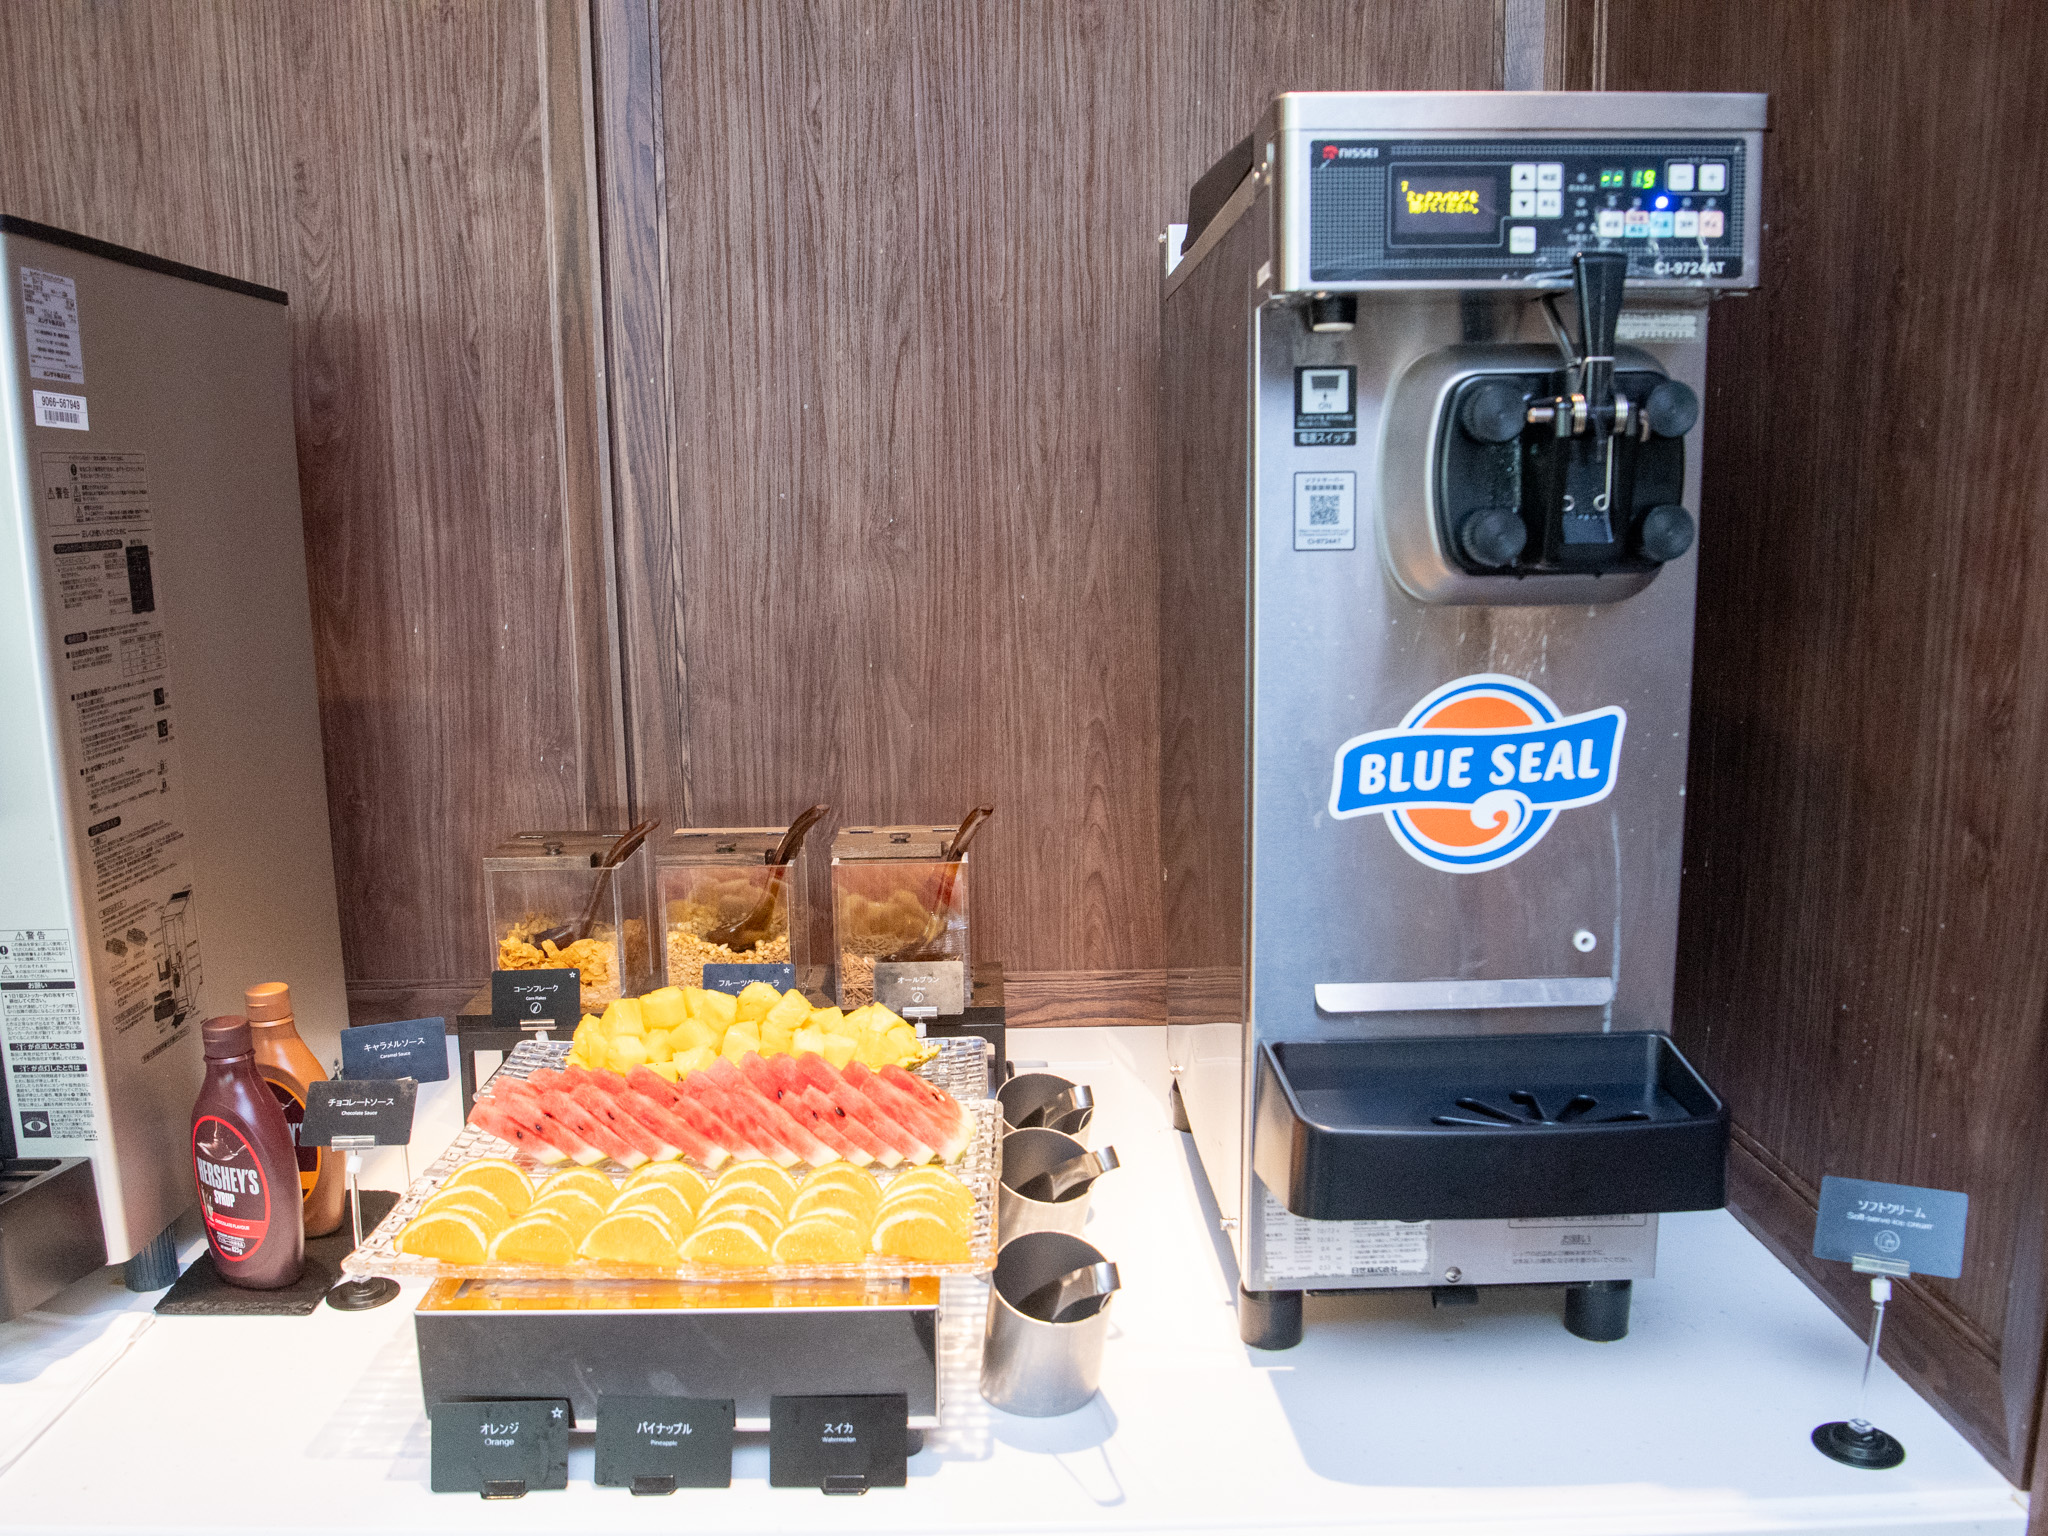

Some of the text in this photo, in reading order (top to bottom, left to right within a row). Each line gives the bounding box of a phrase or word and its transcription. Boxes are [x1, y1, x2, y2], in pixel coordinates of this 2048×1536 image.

[1653, 261, 1726, 275] CI-9724AT
[1358, 738, 1600, 795] BLUE SEAL
[26, 931, 46, 940] 警告
[897, 976, 940, 984] オールブラン
[513, 984, 559, 993] コーンフレーク
[363, 1037, 426, 1052] キャラメルソース
[327, 1098, 395, 1107] チョコレートソース
[196, 1156, 260, 1196] HERSHEY'S
[213, 1189, 236, 1208] SYRUP
[1857, 1200, 1927, 1219] ソフトクリーム
[1846, 1211, 1891, 1225] Soft-serve
[480, 1422, 520, 1435] オレンジ
[636, 1421, 692, 1436] パイナップル
[823, 1422, 854, 1434] スイカ
[484, 1438, 515, 1447] Orange
[650, 1439, 678, 1447] Pineapple
